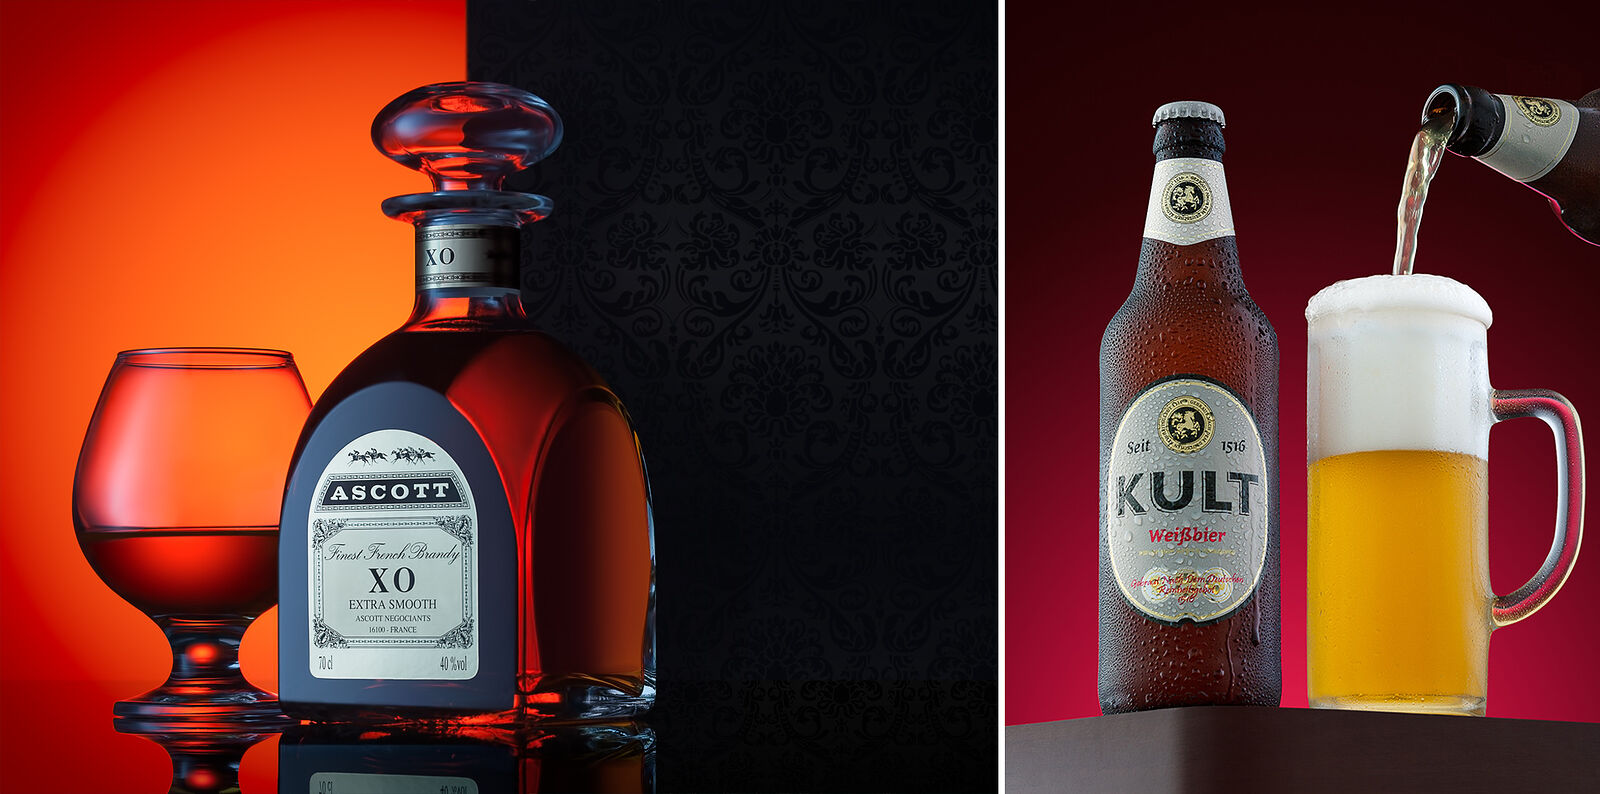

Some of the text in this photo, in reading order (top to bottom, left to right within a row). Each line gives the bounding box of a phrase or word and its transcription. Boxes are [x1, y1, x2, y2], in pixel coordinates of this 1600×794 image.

[426, 247, 455, 267] XO
[1126, 440, 1151, 454] Seit
[1220, 440, 1246, 454] 1516
[330, 482, 450, 501] ASCOTT
[1115, 470, 1259, 517] KULT
[1149, 527, 1226, 546] Weißbier
[324, 541, 460, 566] Finest French Brandy
[368, 566, 416, 594] XO
[349, 599, 437, 610] EXTRA SMOOTH
[384, 614, 431, 622] NEGOCIANTS
[318, 655, 333, 670] 70 cl
[440, 656, 449, 671] 40
